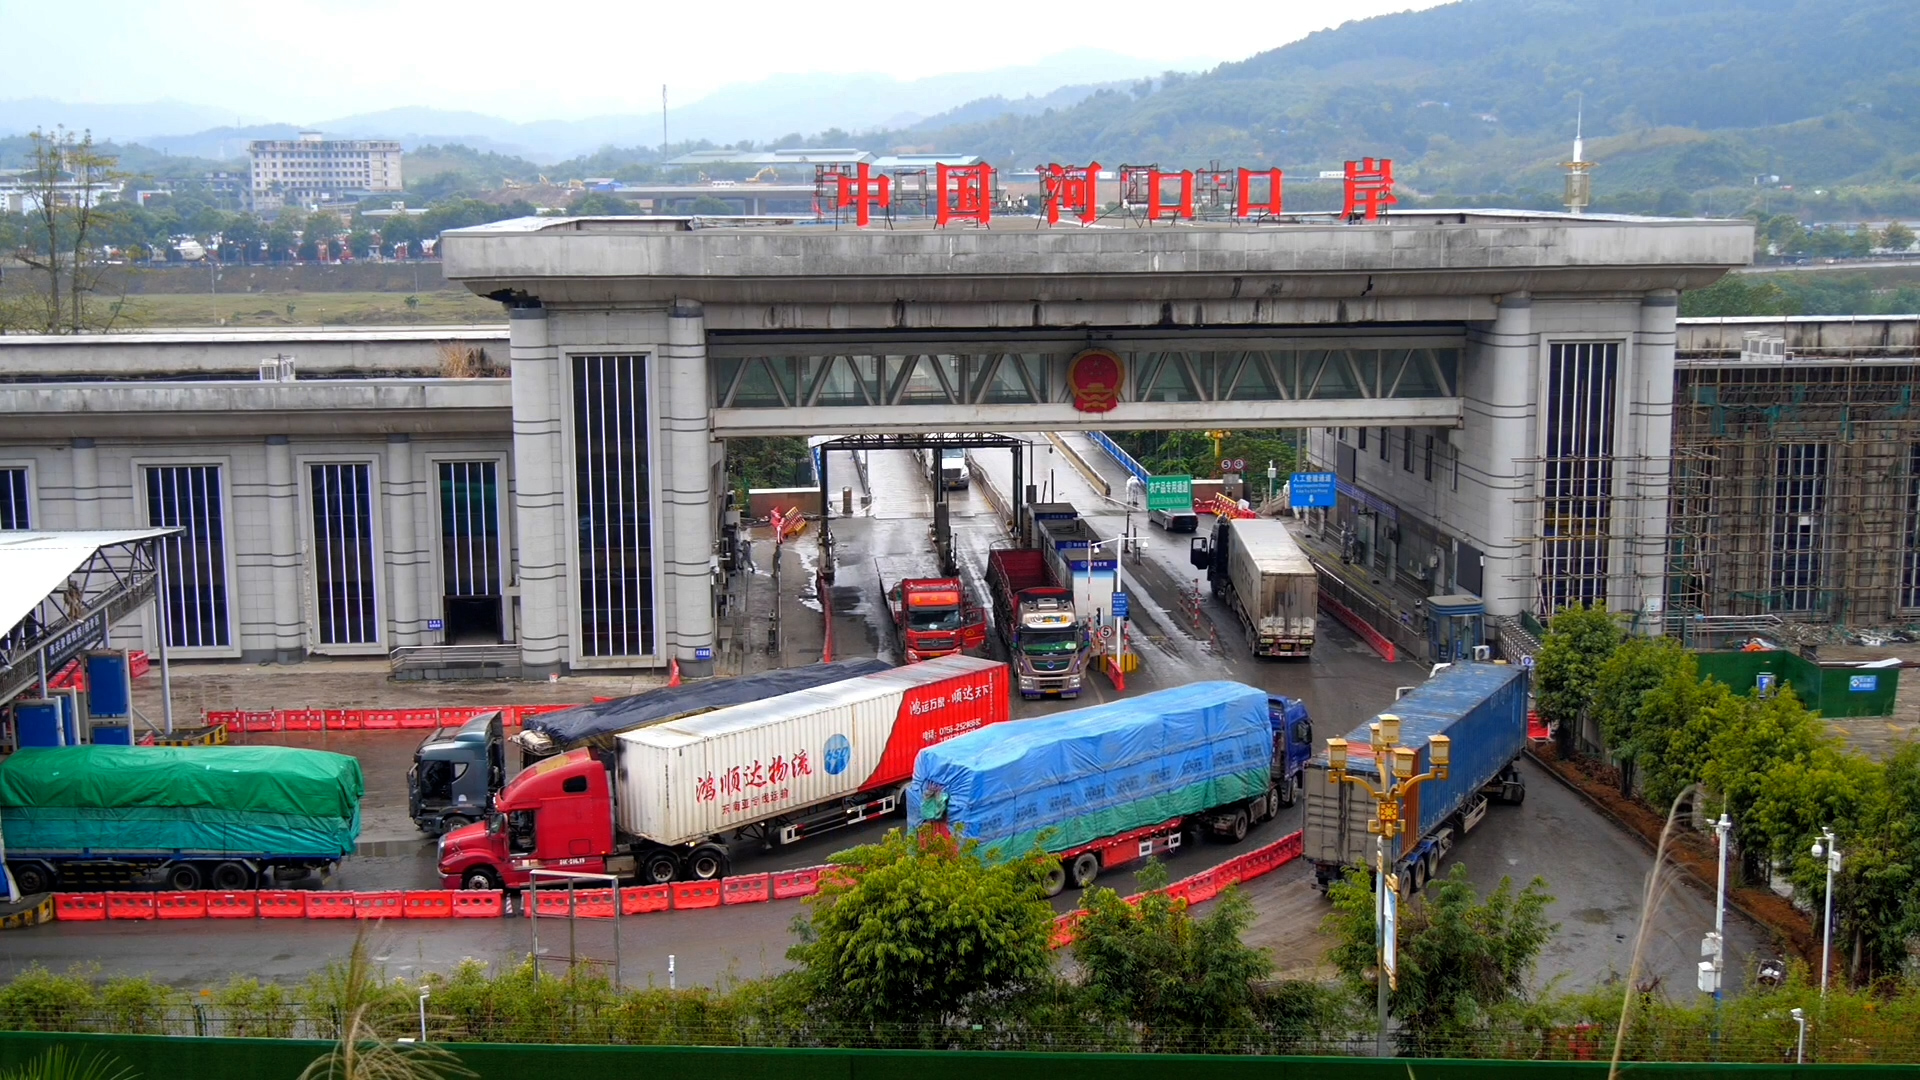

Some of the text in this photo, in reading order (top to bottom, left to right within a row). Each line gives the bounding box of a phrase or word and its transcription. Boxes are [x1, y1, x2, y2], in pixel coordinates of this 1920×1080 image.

[837, 157, 1399, 228] 中国河口口岸
[1149, 481, 1188, 493] 农产品专用通道
[1103, 627, 1109, 636] 5
[695, 748, 813, 804] 鸿顺达物流
[721, 788, 790, 815] 东南亚专线运输
